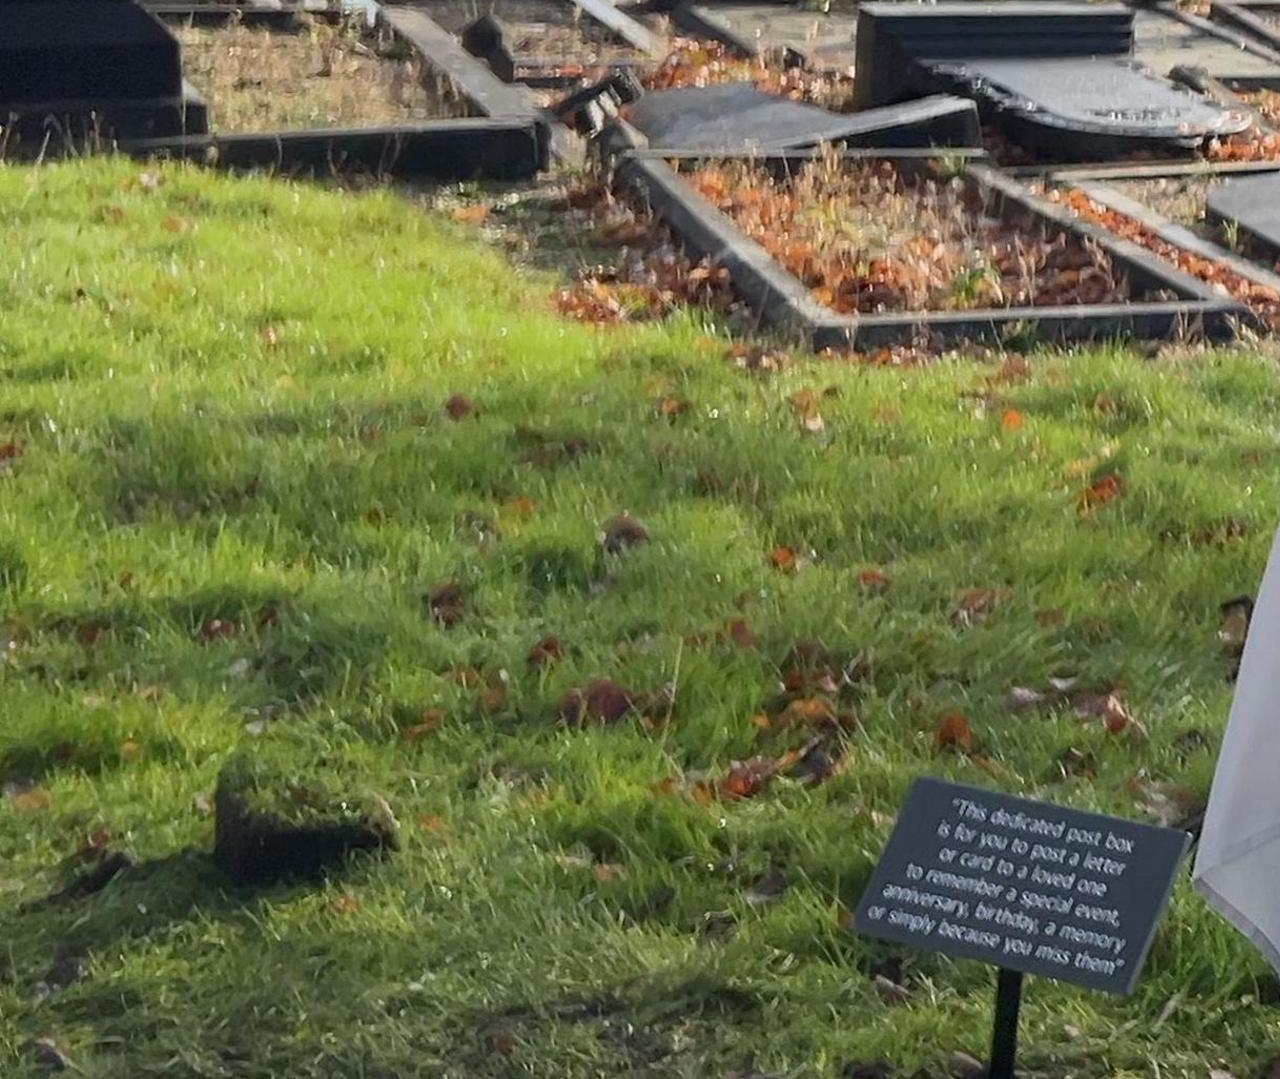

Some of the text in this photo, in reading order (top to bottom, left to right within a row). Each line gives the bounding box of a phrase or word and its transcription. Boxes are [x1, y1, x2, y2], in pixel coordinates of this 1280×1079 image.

[936, 820, 1126, 875] is for you to post a letter
[990, 808, 1066, 838] dedicated
[1065, 827, 1102, 846] post
[1105, 831, 1135, 853] box
[906, 862, 923, 880] to
[926, 869, 1004, 898] remember
[1006, 887, 1017, 901] a
[1020, 891, 1073, 914] special
[939, 847, 1107, 896] or card to a loved one
[868, 906, 887, 920] or
[888, 907, 936, 935] simply
[938, 918, 1000, 948] because
[1003, 937, 1032, 956] you
[1035, 945, 1071, 965] miss
[1045, 922, 1056, 936] a
[1059, 926, 1126, 954] memory
